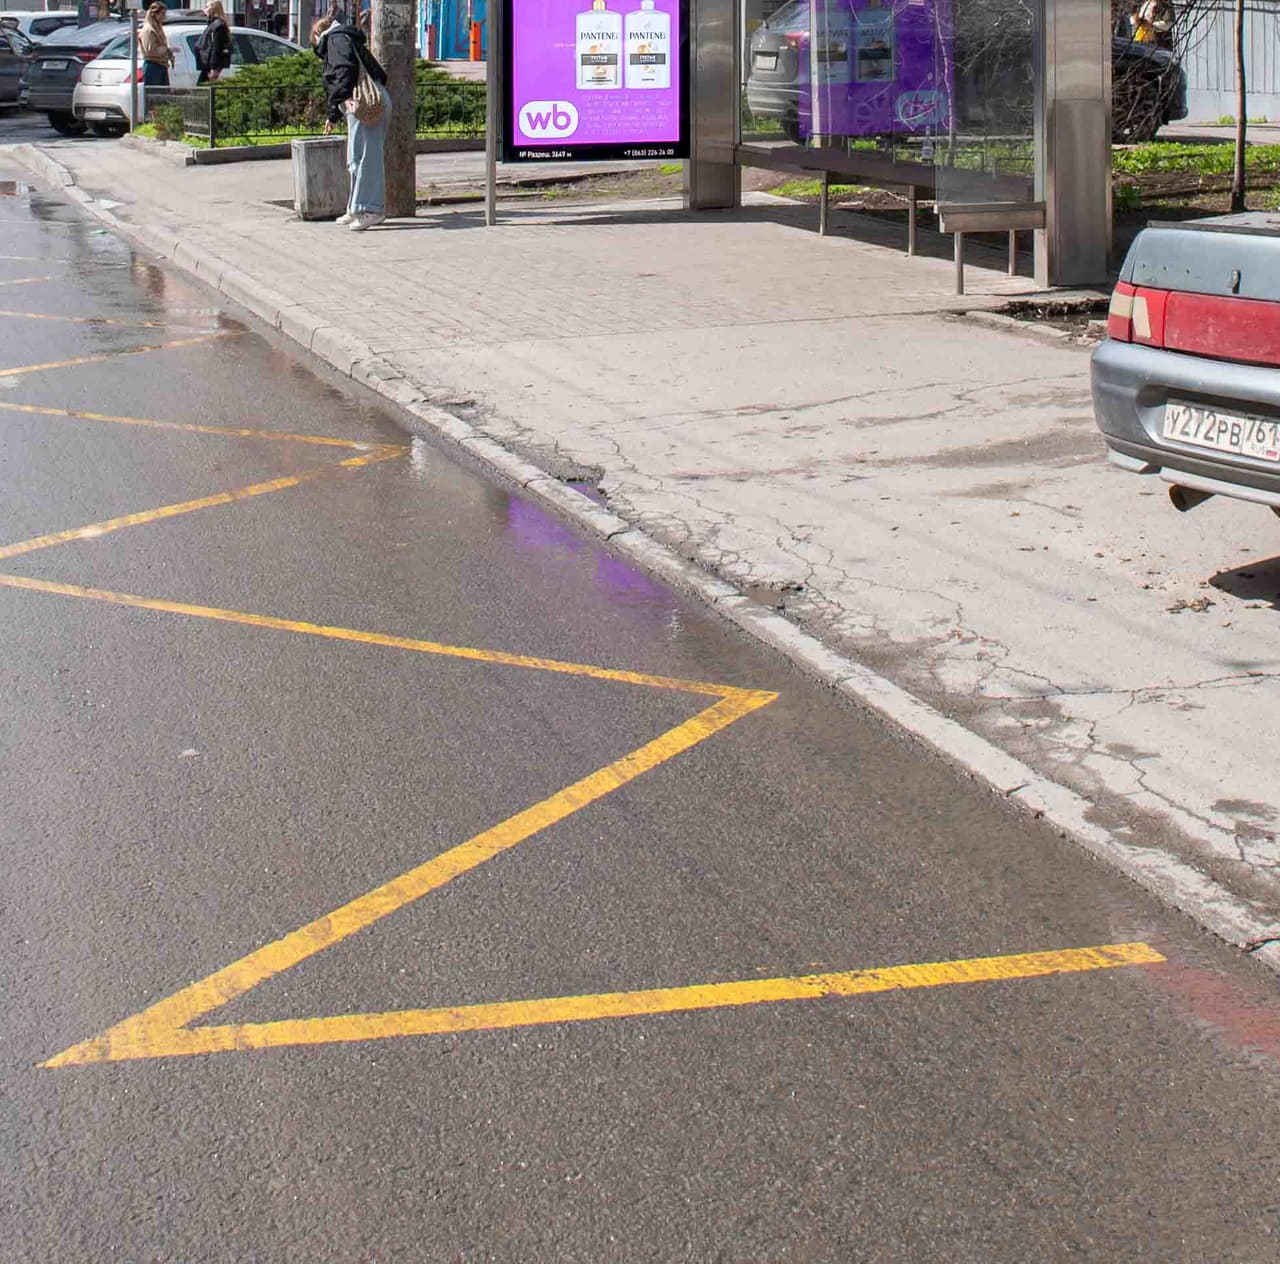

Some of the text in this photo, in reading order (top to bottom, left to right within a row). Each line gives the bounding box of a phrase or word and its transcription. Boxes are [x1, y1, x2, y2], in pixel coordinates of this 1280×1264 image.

[580, 31, 618, 41] PANTENE
[629, 31, 666, 41] PANTENE
[526, 103, 571, 131] wb
[1169, 405, 1278, 447] У272РВ 761
